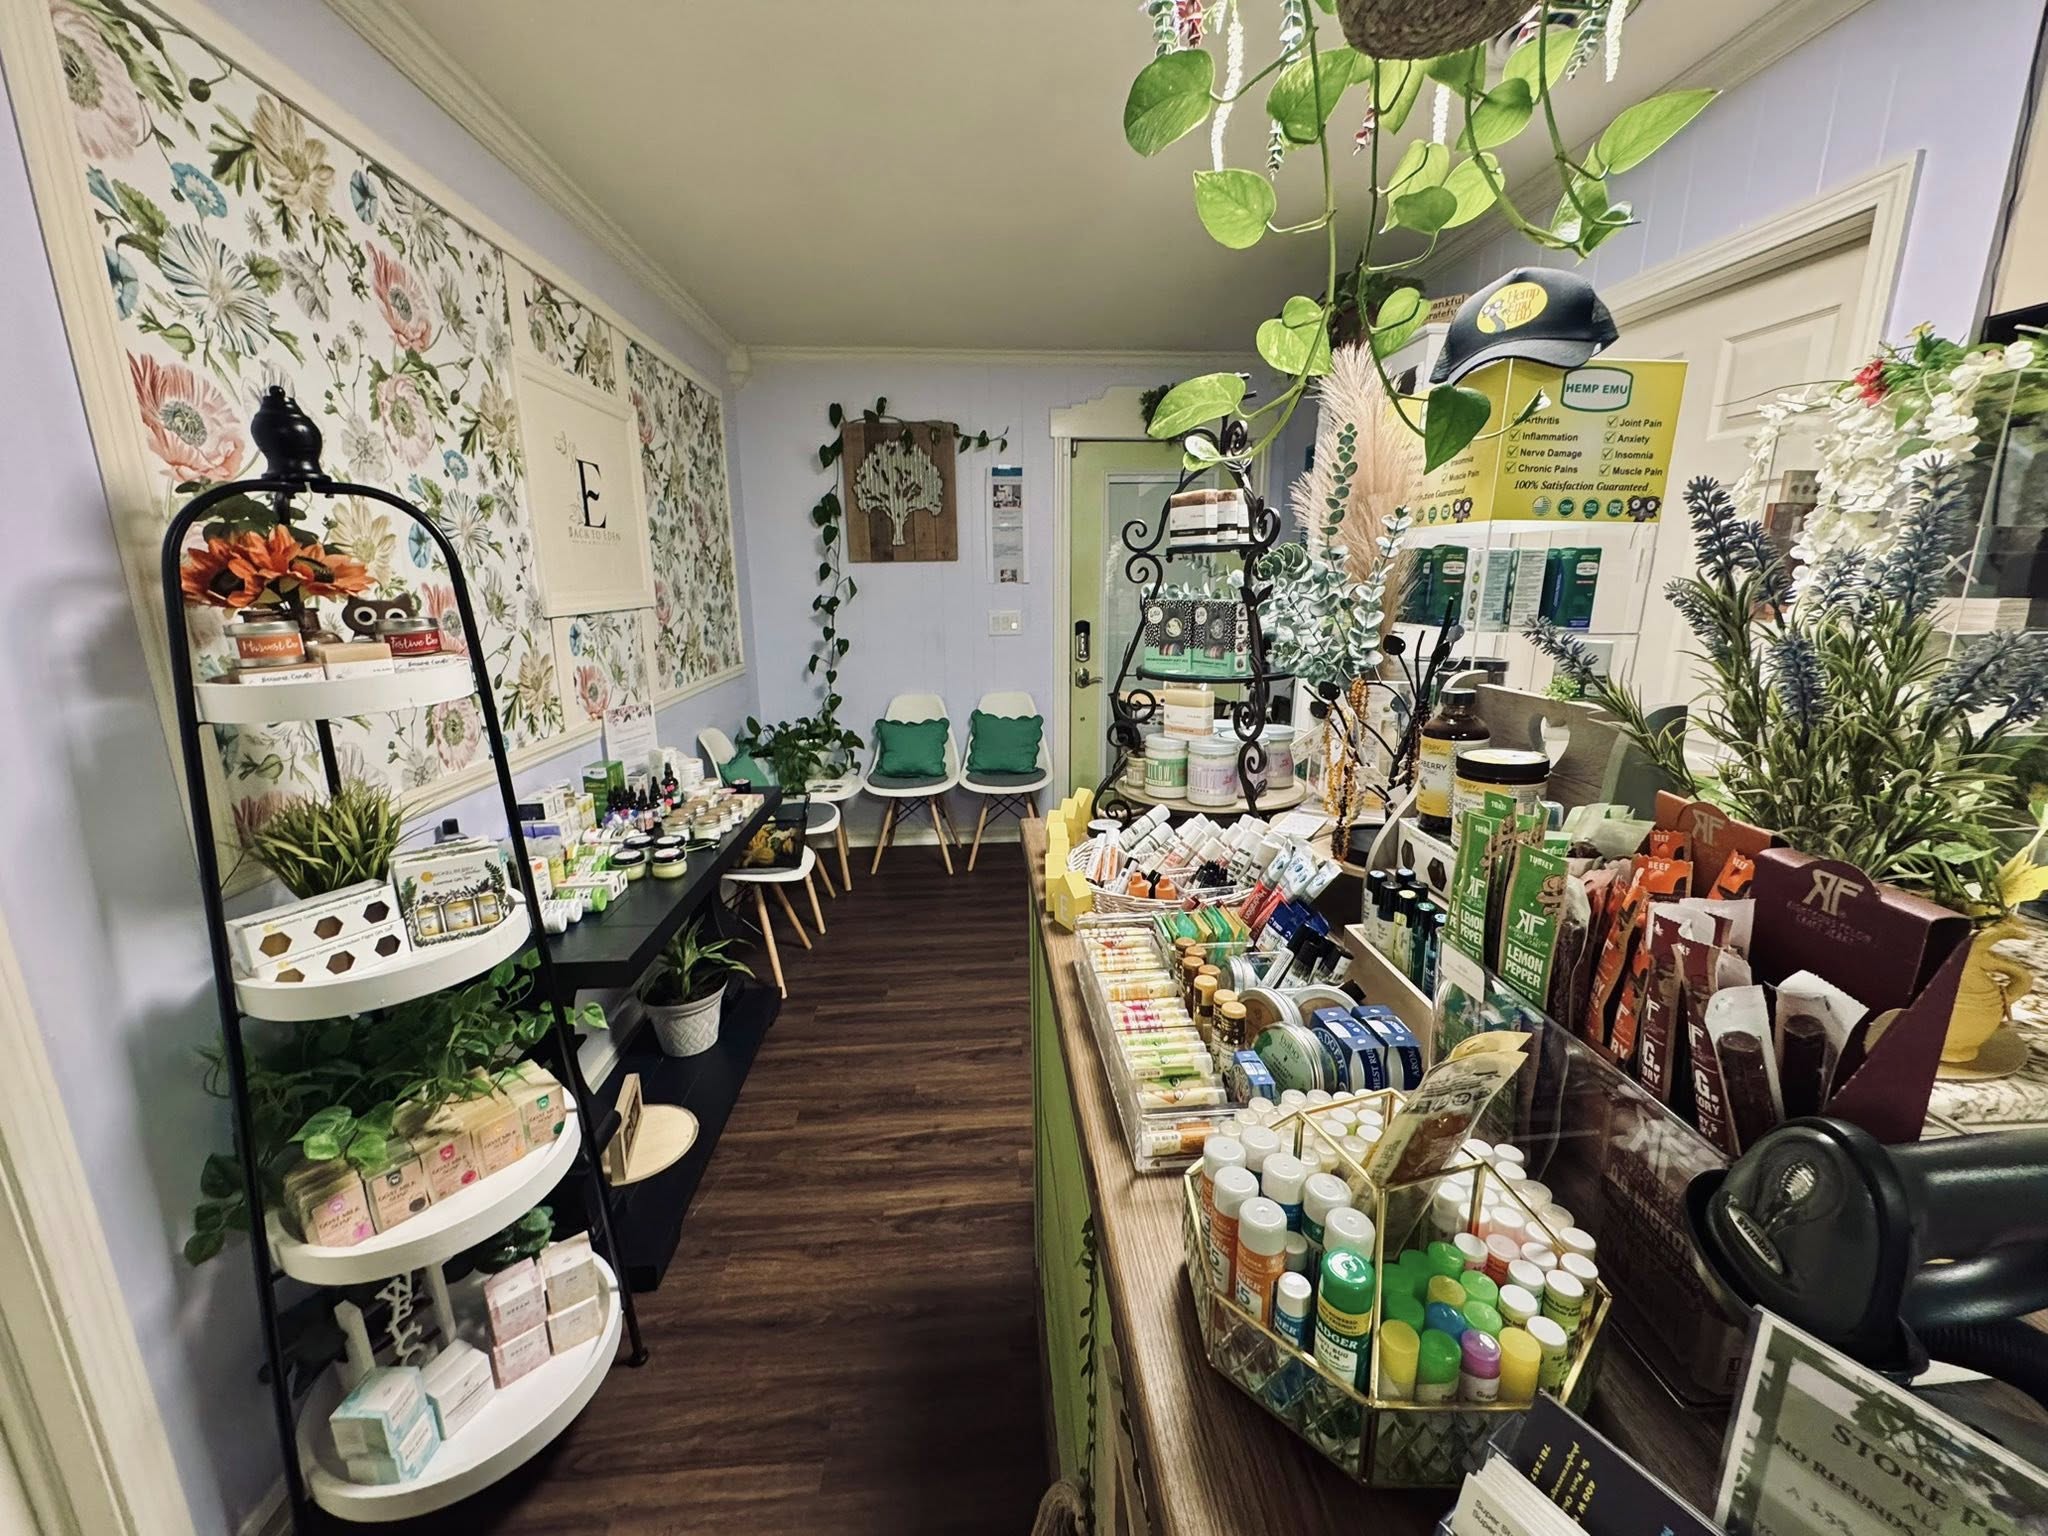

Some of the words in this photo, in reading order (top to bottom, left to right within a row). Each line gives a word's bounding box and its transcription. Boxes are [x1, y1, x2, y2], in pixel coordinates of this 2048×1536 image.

[1431, 294, 1465, 310] ankful
[1566, 383, 1599, 394] HEMP
[1602, 384, 1628, 394] EMU
[1619, 418, 1641, 427] Joint
[1643, 419, 1662, 427] Pain
[1522, 432, 1579, 442] Inflammation
[1617, 434, 1650, 445] Anxiety
[1520, 448, 1545, 457] Nerve
[1547, 449, 1583, 458] Damage
[1615, 451, 1654, 460] Insomnia
[1518, 464, 1552, 473] Chronic
[1554, 464, 1578, 473] Pains
[1612, 467, 1642, 476] Muscle
[1644, 468, 1663, 476] Pain
[1514, 480, 1539, 490] 100%
[1541, 481, 1594, 492] Satisfaction
[1596, 481, 1649, 492] Guaranteed
[576, 459, 607, 529] E
[1421, 761, 1448, 771] BERRY
[1653, 833, 1670, 843] BEEF
[1648, 862, 1670, 872] BEEF
[1507, 943, 1544, 974] LEMON
[1505, 960, 1541, 988] PEPPER
[1317, 1032, 1346, 1070] ADGER
[1407, 1046, 1420, 1077] AROM
[1832, 1423, 1949, 1512] STORE
[1580, 1478, 1596, 1502] 400
[1775, 1435, 1807, 1464] NO
[1812, 1459, 1917, 1536] REFUNDS
[1475, 1499, 1499, 1528] Super
